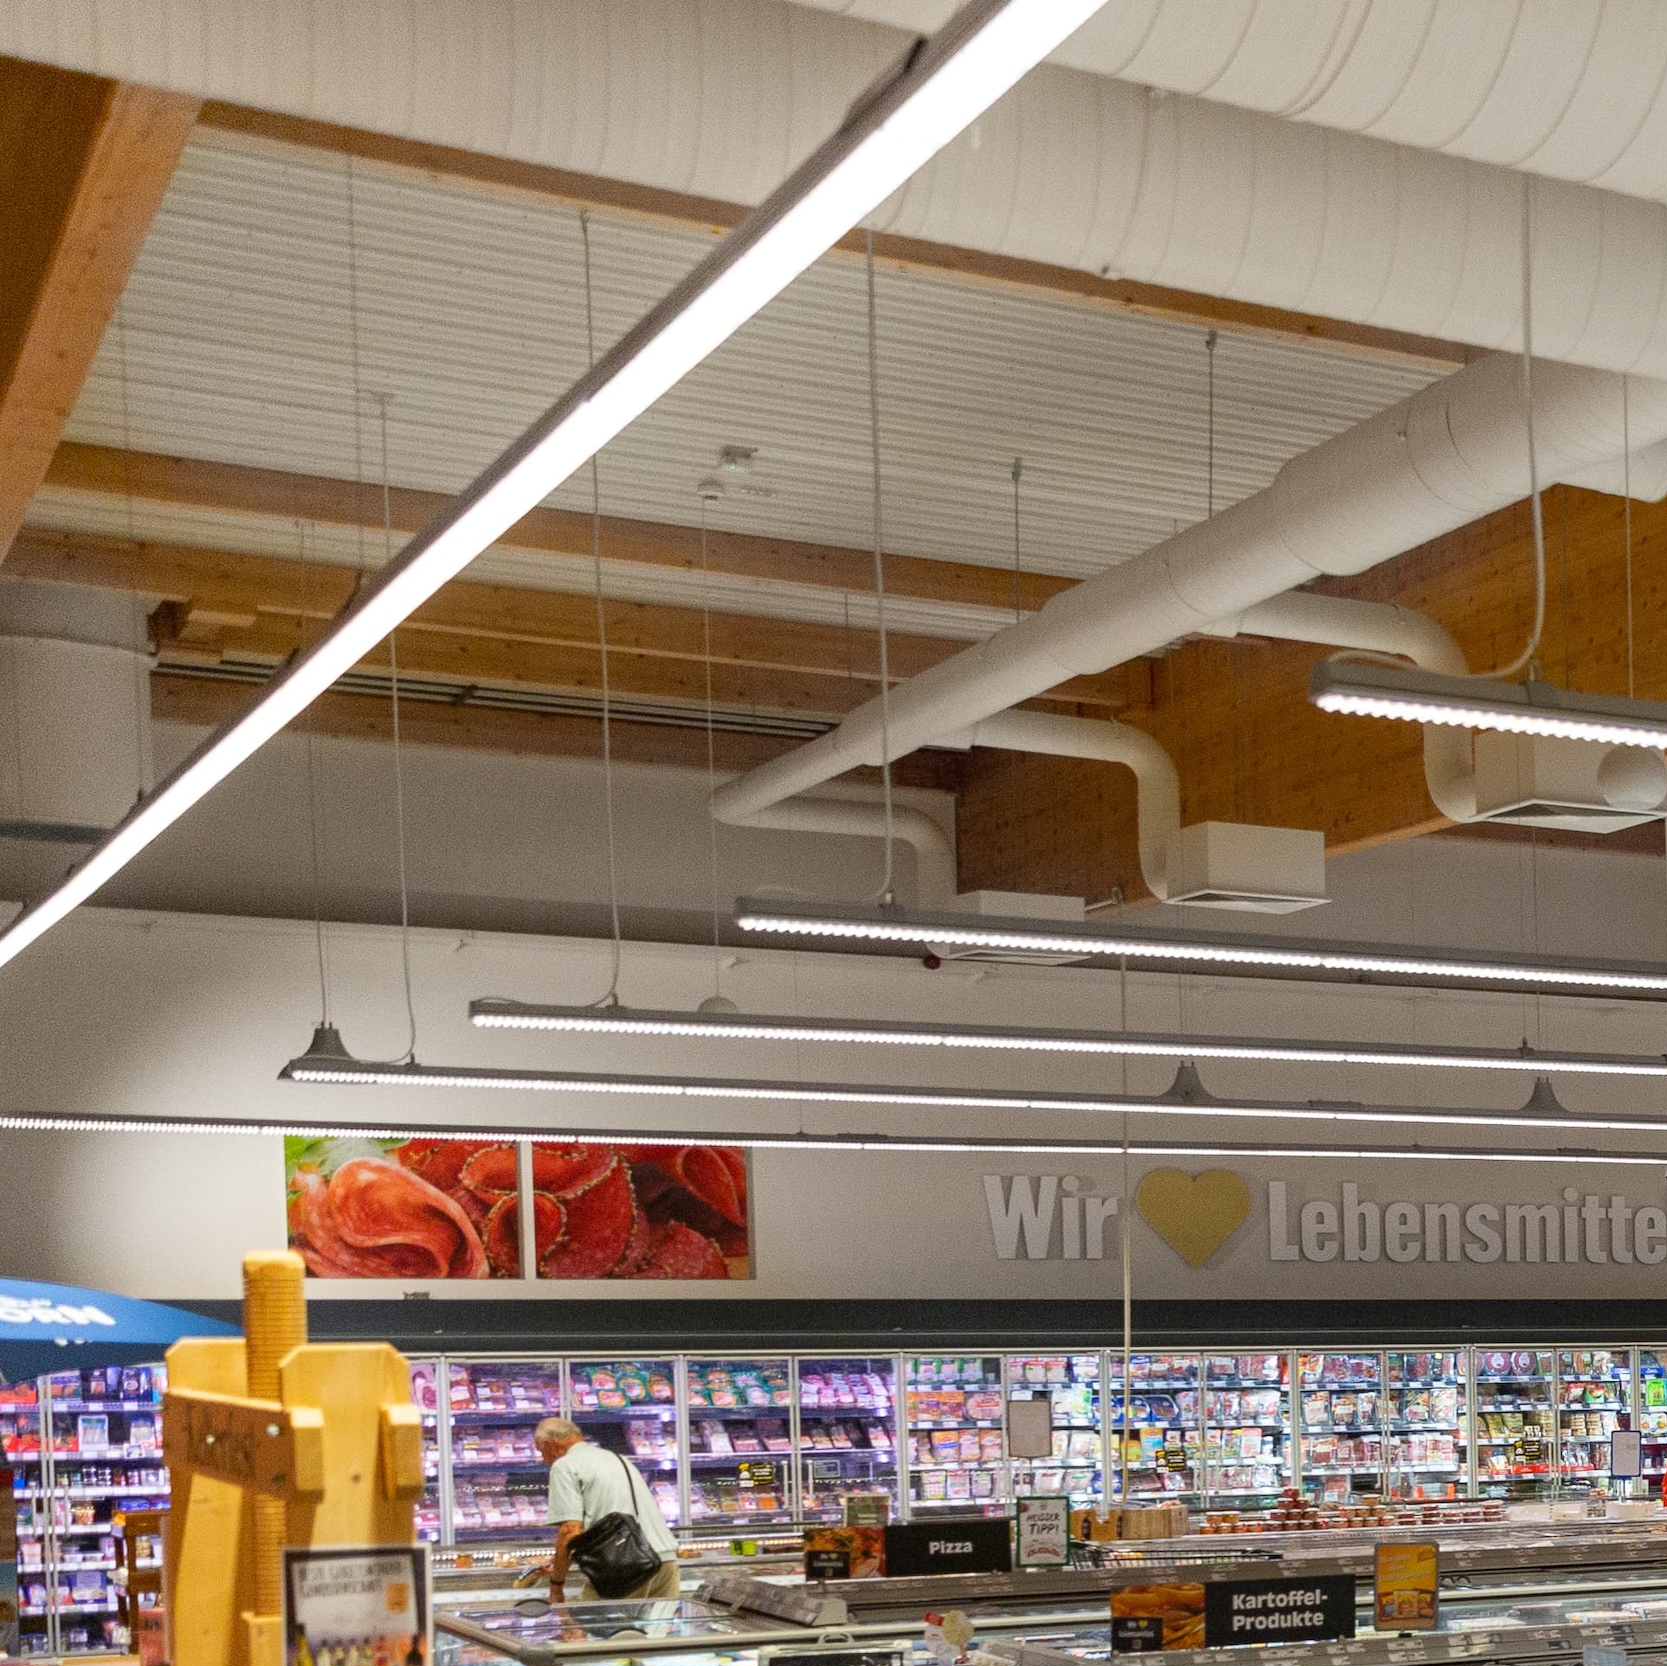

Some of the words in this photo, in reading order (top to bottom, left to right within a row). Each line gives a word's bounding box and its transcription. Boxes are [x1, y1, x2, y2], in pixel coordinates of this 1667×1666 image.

[983, 1175, 1118, 1260] Wir
[1029, 1523, 1059, 1535] TIPP!
[928, 1538, 973, 1557] Pizza
[1232, 1589, 1329, 1612] Kartoffel-
[1232, 1610, 1325, 1632] Produkte
